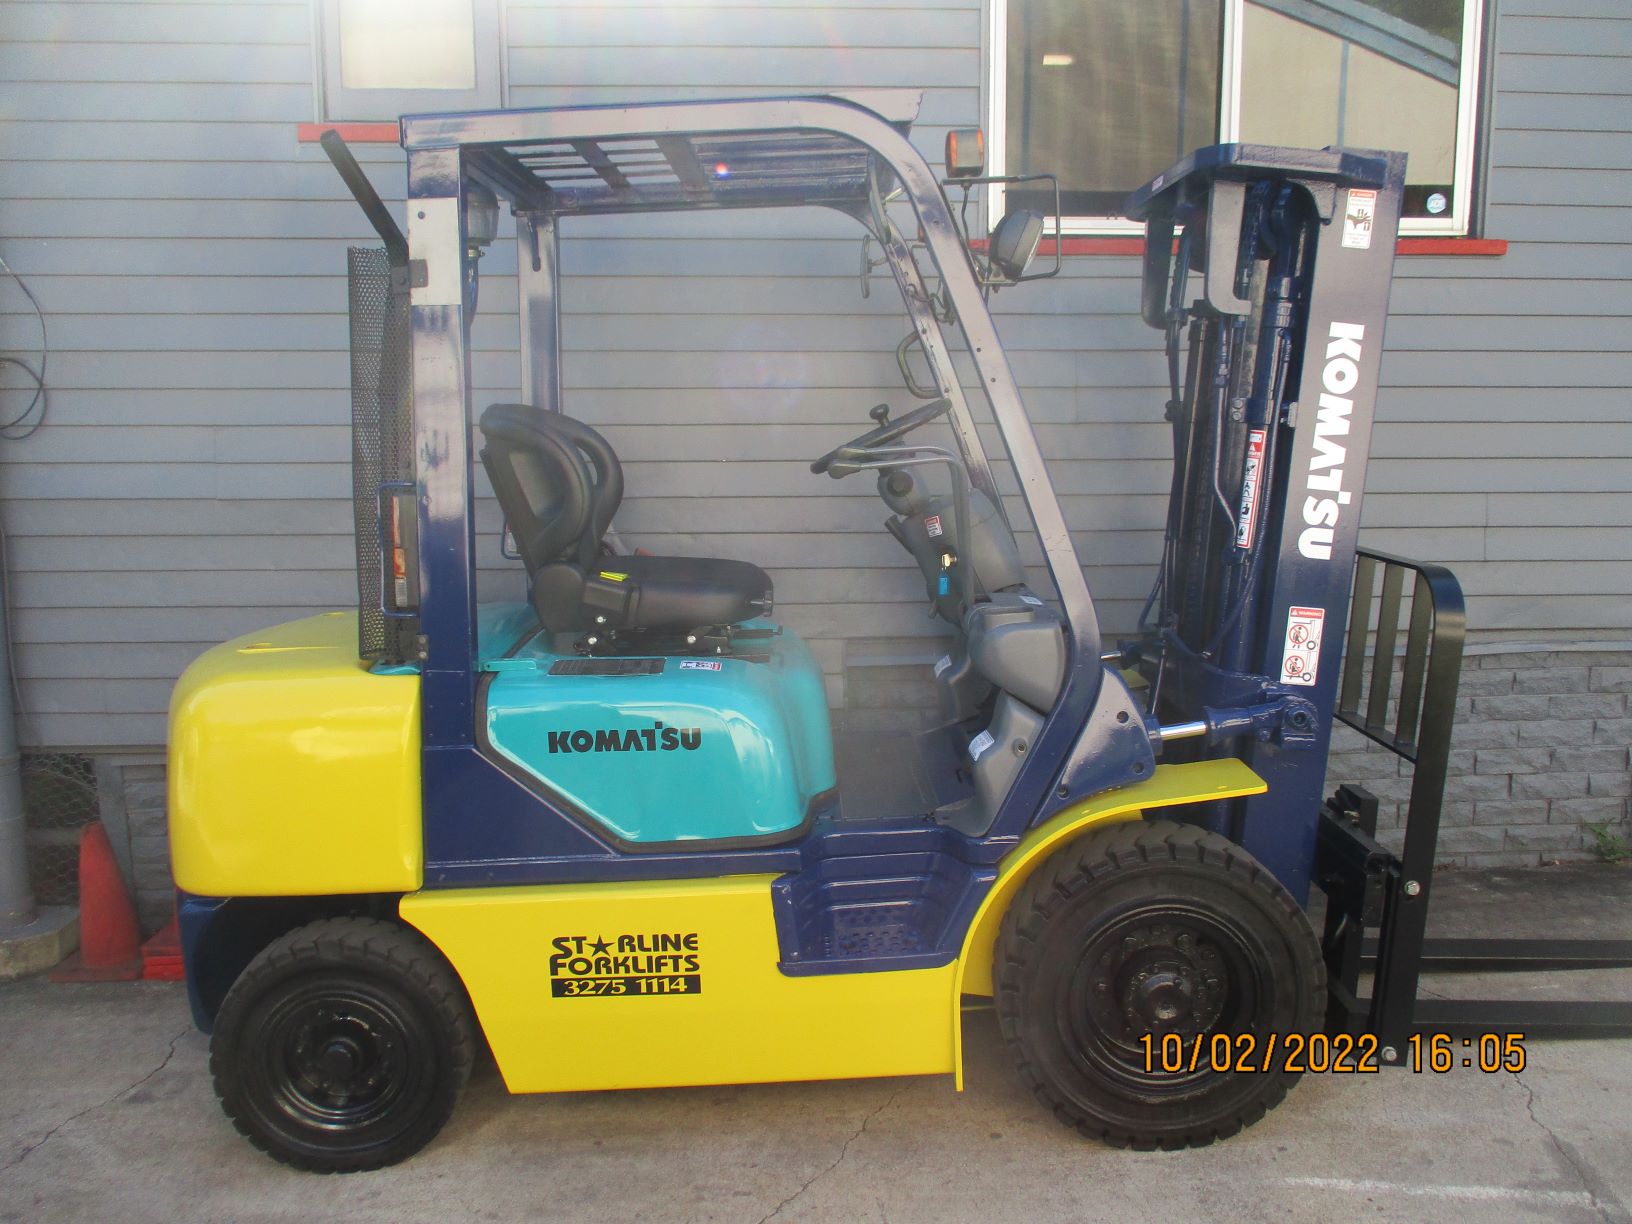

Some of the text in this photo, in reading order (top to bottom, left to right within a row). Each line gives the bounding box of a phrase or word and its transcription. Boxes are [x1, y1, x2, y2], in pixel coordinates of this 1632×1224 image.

[1298, 321, 1365, 560] KOMATSU
[547, 721, 702, 753] KOMATSU
[549, 953, 700, 976] FORKLIFTS
[564, 977, 688, 996] 3275 1114
